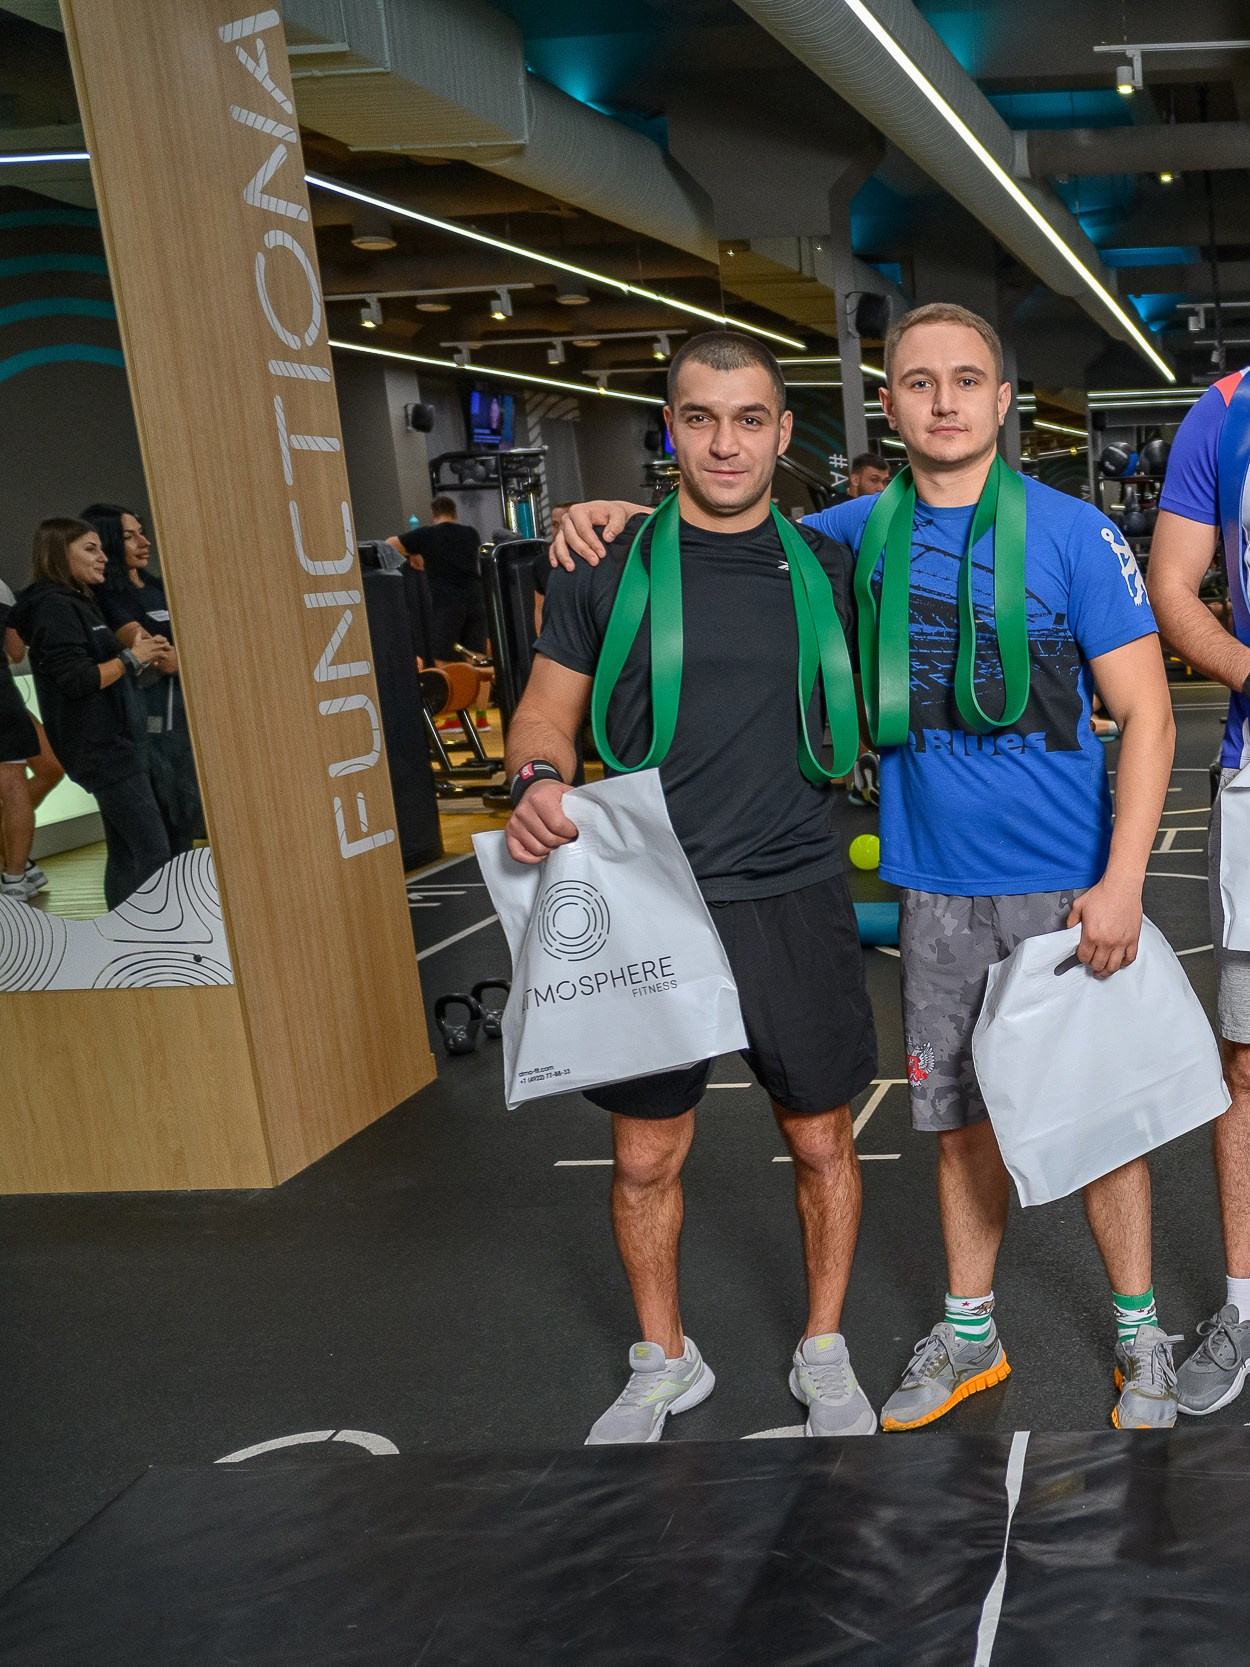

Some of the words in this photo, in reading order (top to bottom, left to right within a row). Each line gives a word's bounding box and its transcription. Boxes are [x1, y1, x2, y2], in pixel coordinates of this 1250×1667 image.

[923, 728, 1047, 756] Blues
[522, 955, 675, 1014] TMOSPHERE
[632, 979, 678, 998] FITNESS
